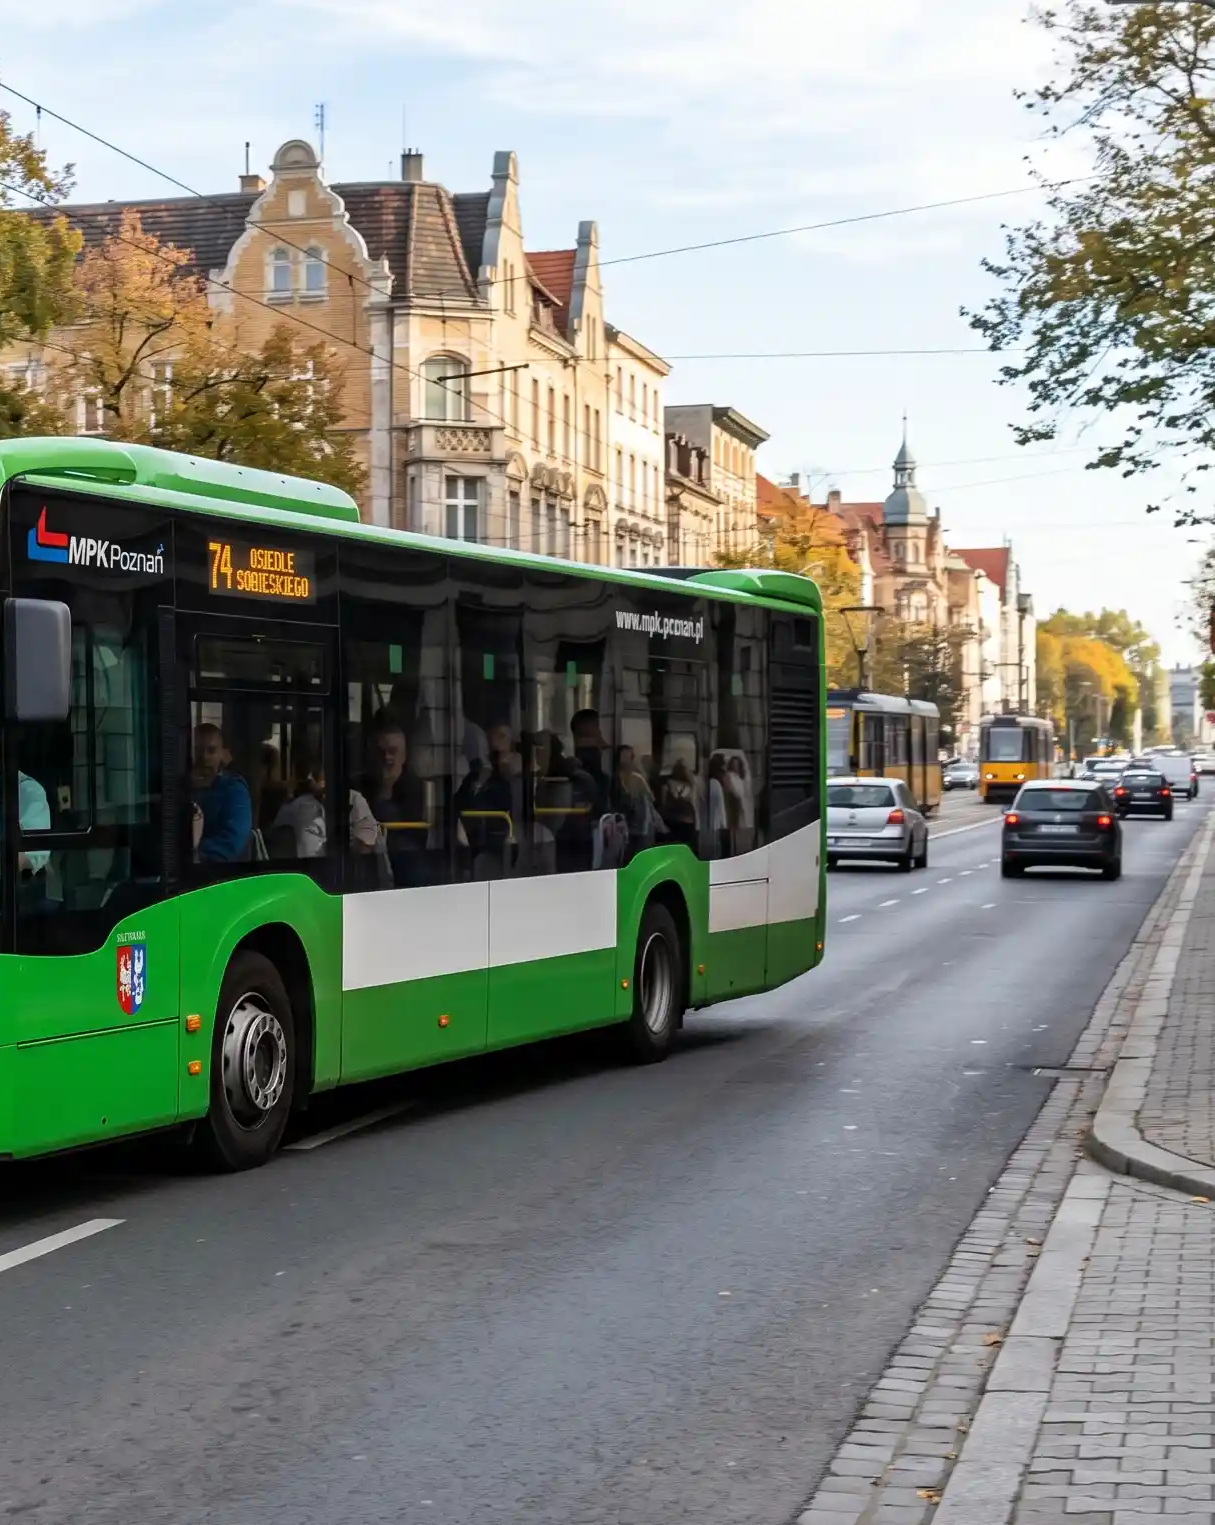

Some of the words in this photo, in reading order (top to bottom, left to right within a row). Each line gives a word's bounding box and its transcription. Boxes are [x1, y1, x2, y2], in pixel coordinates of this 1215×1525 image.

[208, 542, 233, 589] 74
[250, 548, 295, 573] OSIEDLE
[236, 569, 309, 598] SOBIESKIEGO
